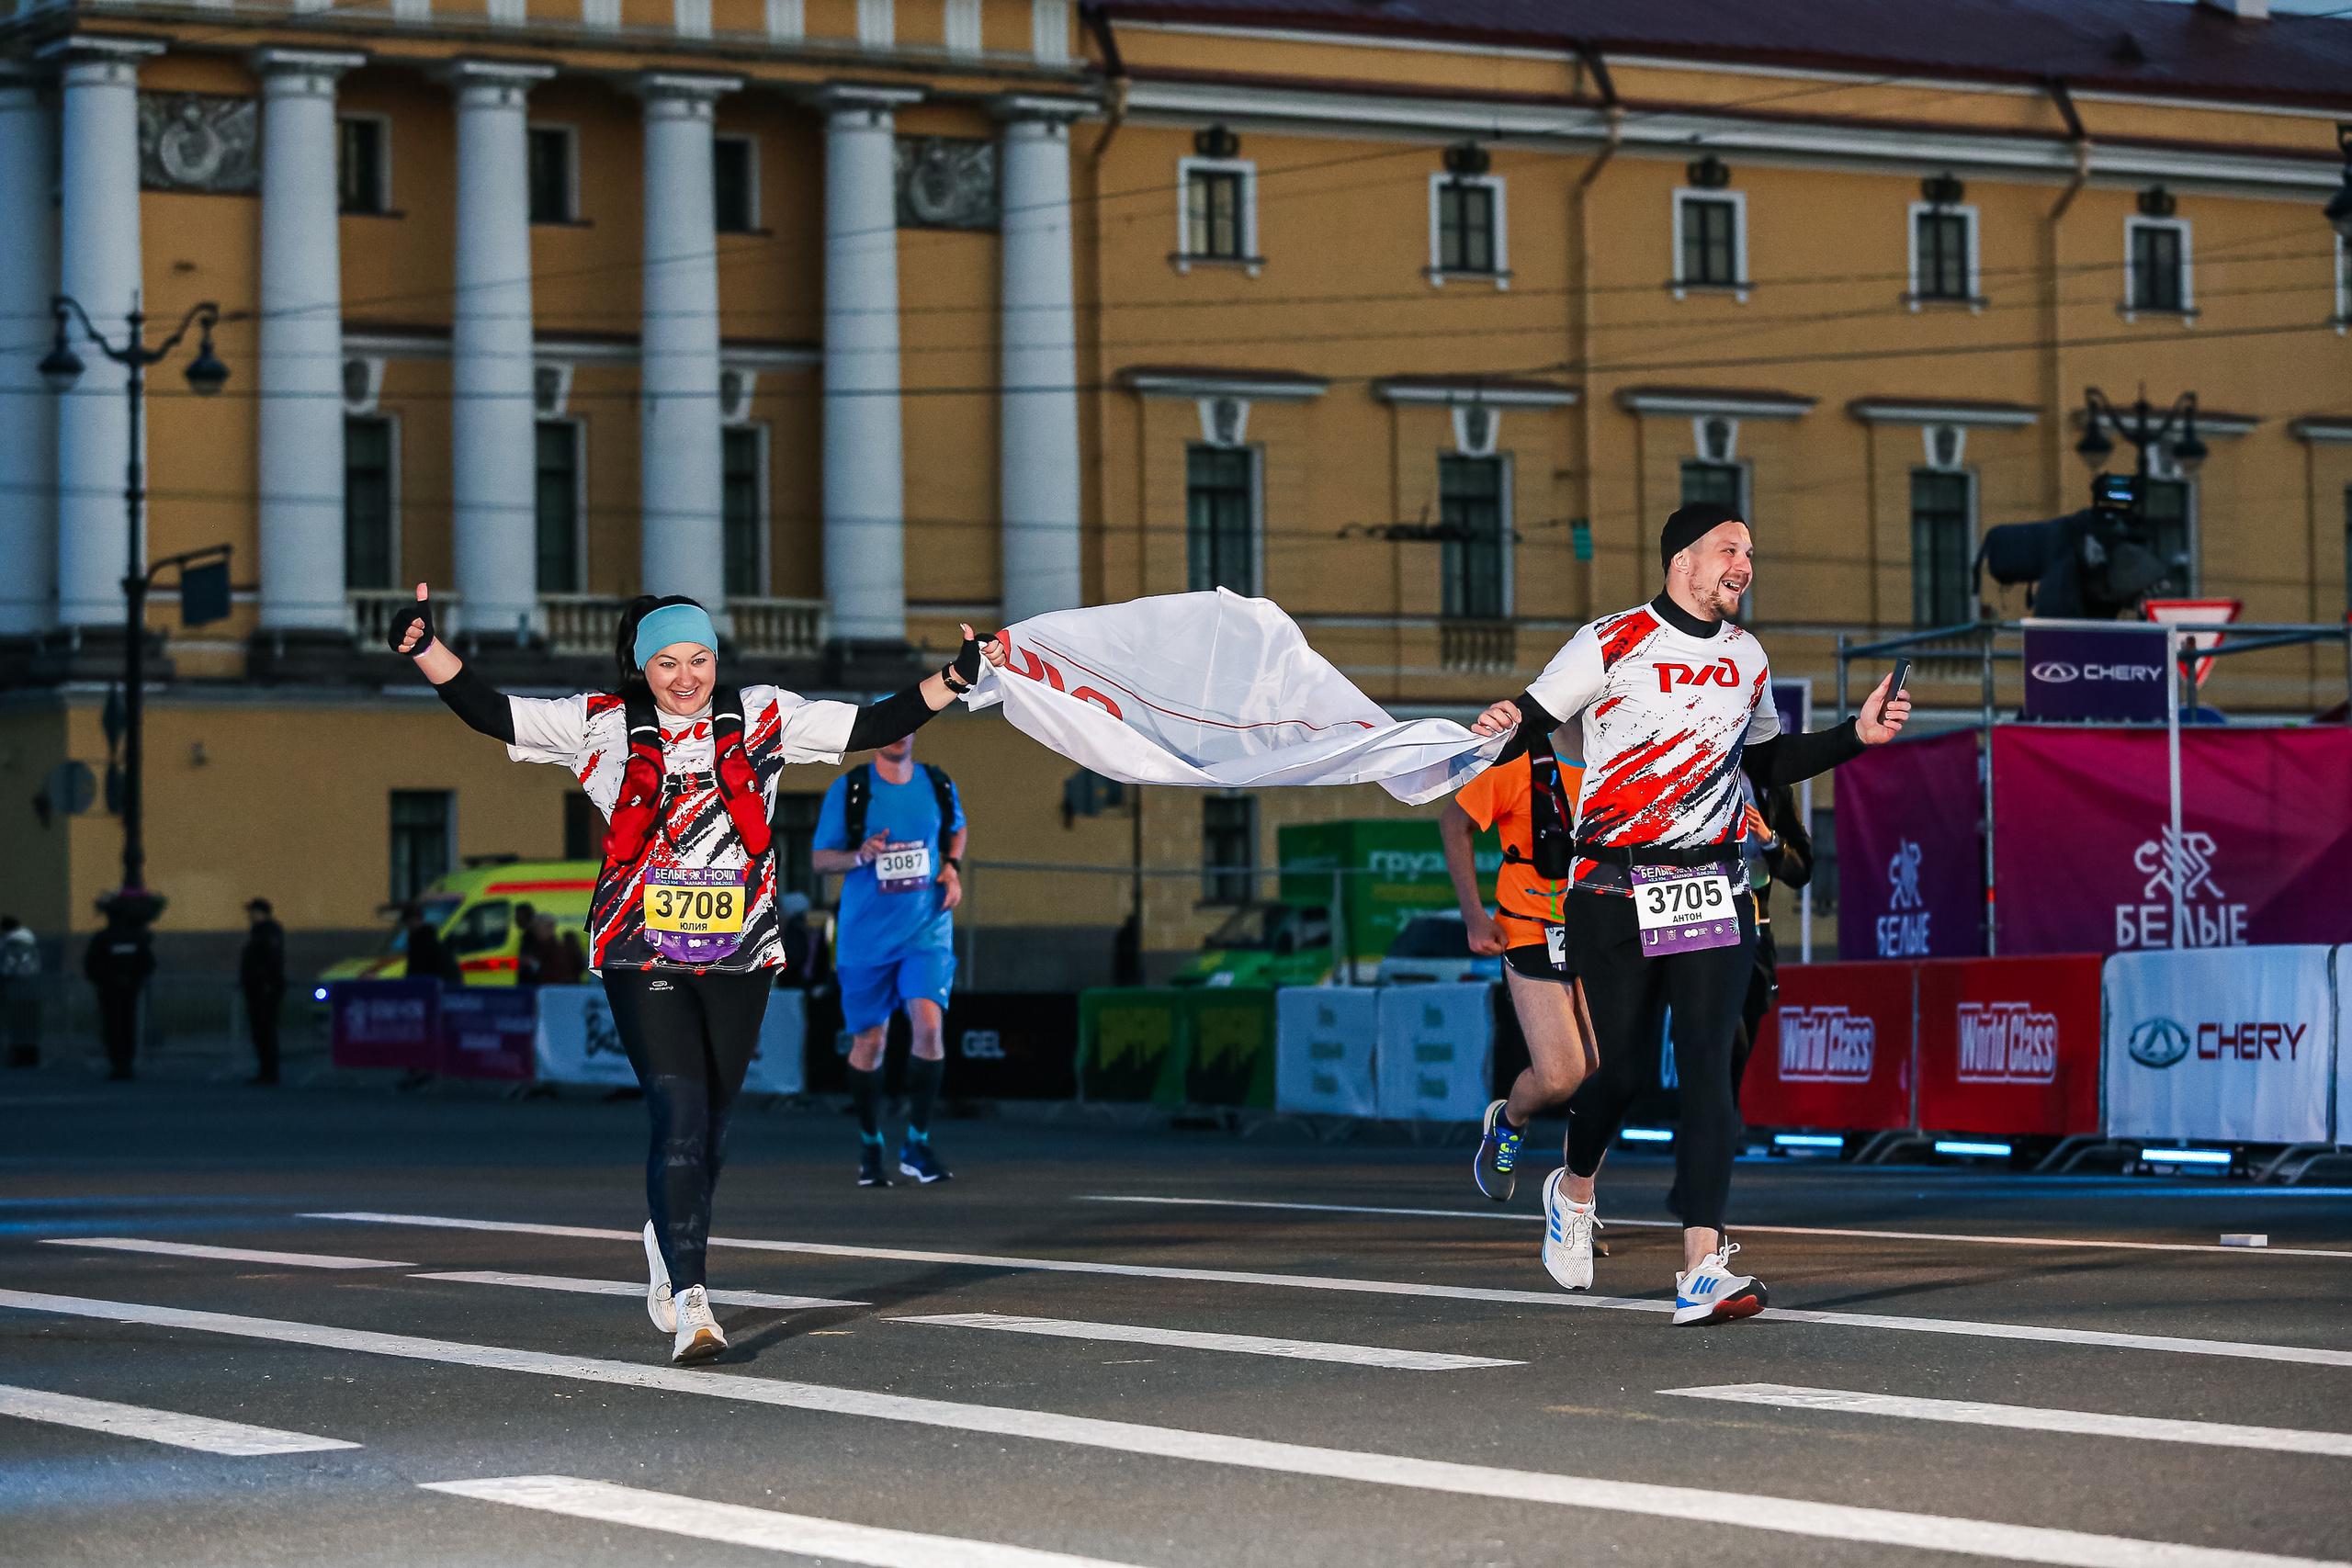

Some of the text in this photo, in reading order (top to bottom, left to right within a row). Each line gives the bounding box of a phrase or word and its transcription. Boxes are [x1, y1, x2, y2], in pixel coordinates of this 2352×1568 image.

[2084, 663, 2163, 682] CHERY
[655, 868, 736, 881] БЕЛЫЕ НОЧИ
[883, 852, 922, 872] 3087
[1640, 866, 1675, 879] БЕЛЫЕ
[655, 889, 733, 919] 3708
[1647, 880, 1723, 914] 3705
[680, 922, 707, 931] ЮЛИЯ
[1672, 912, 1702, 923] АНТОН
[2116, 905, 2247, 947] БЕЛЫЕ
[1876, 912, 1929, 956] БЕЛЫЕ
[1781, 1016, 1871, 1071] World Class
[1961, 1013, 2054, 1071] World Class
[2198, 1014, 2307, 1061] CHERY
